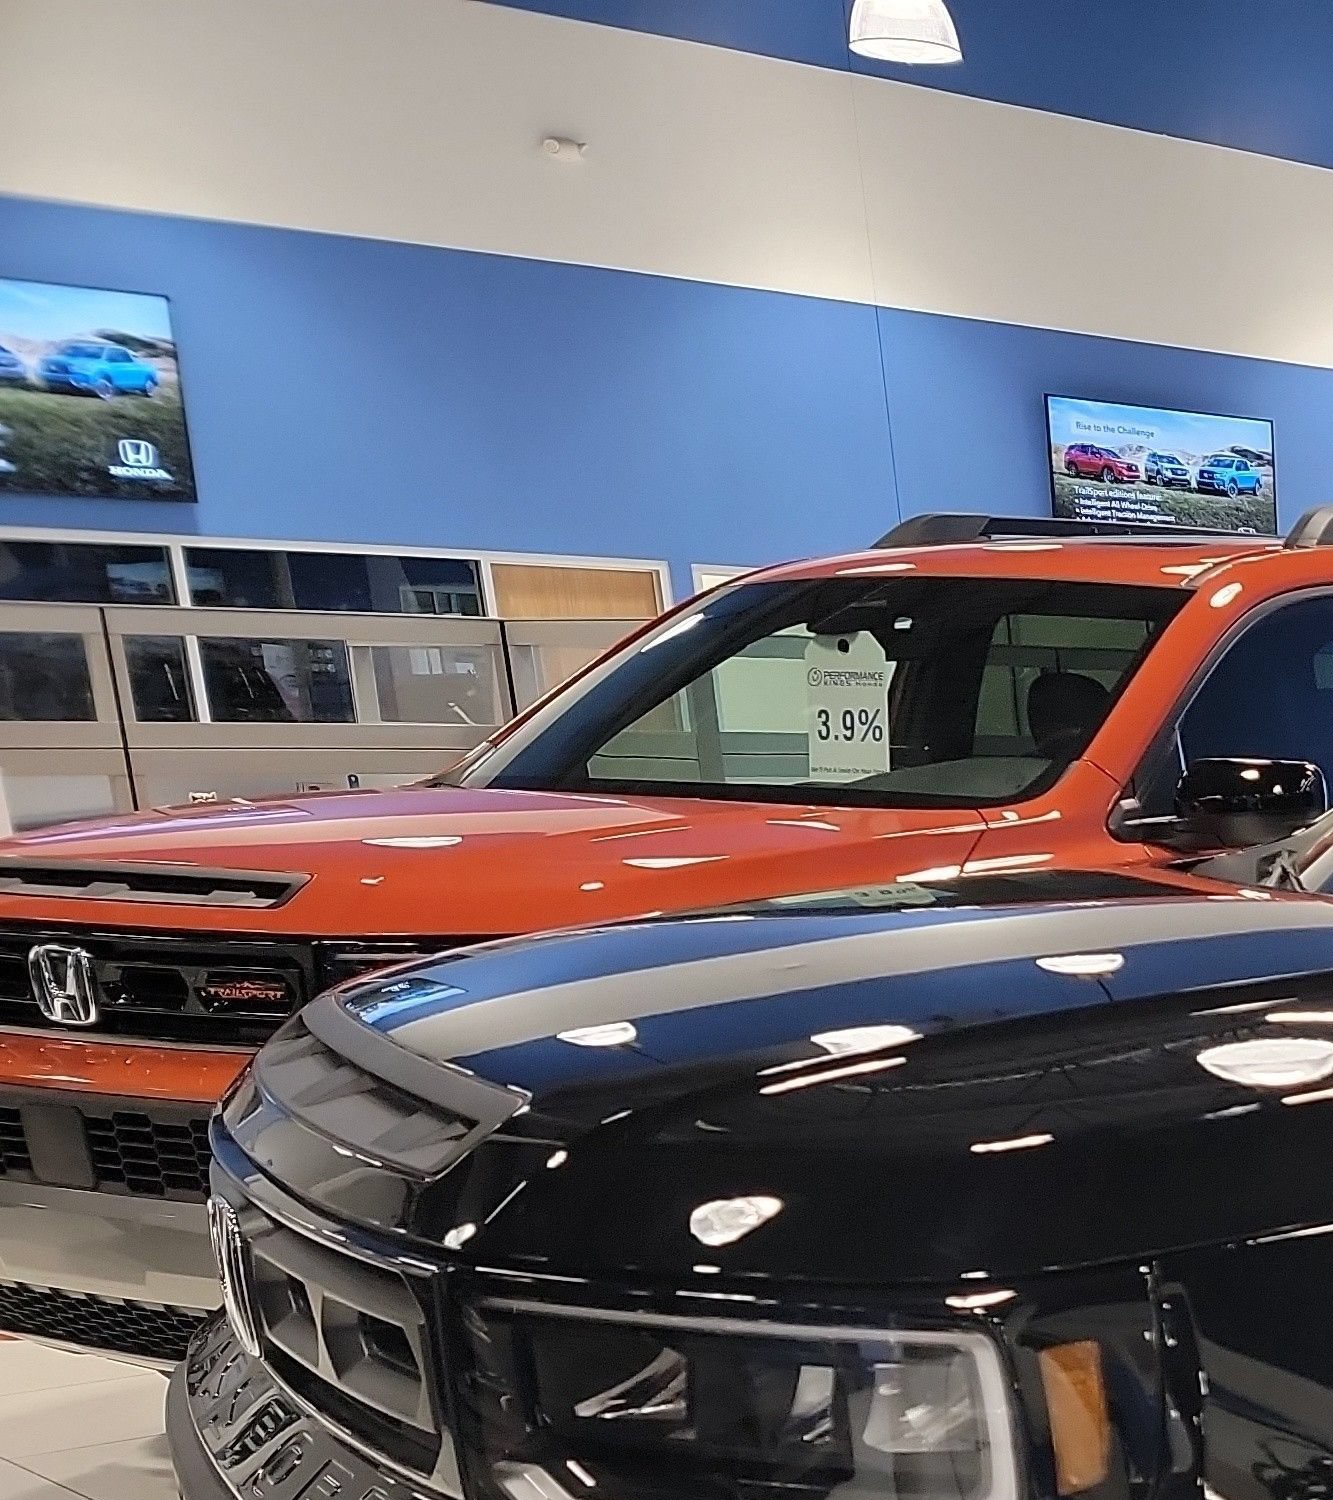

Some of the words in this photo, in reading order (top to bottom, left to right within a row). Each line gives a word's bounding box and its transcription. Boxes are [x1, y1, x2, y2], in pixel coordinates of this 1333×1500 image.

[1076, 421, 1091, 431] Rise
[1094, 423, 1101, 431] to
[1103, 424, 1115, 433] the
[1117, 426, 1154, 439] Challenge
[108, 465, 175, 481] HONDA
[823, 671, 884, 680] PERFORMANCE
[817, 708, 883, 742] 3.9%
[207, 986, 285, 1000] TRAILSPORT
